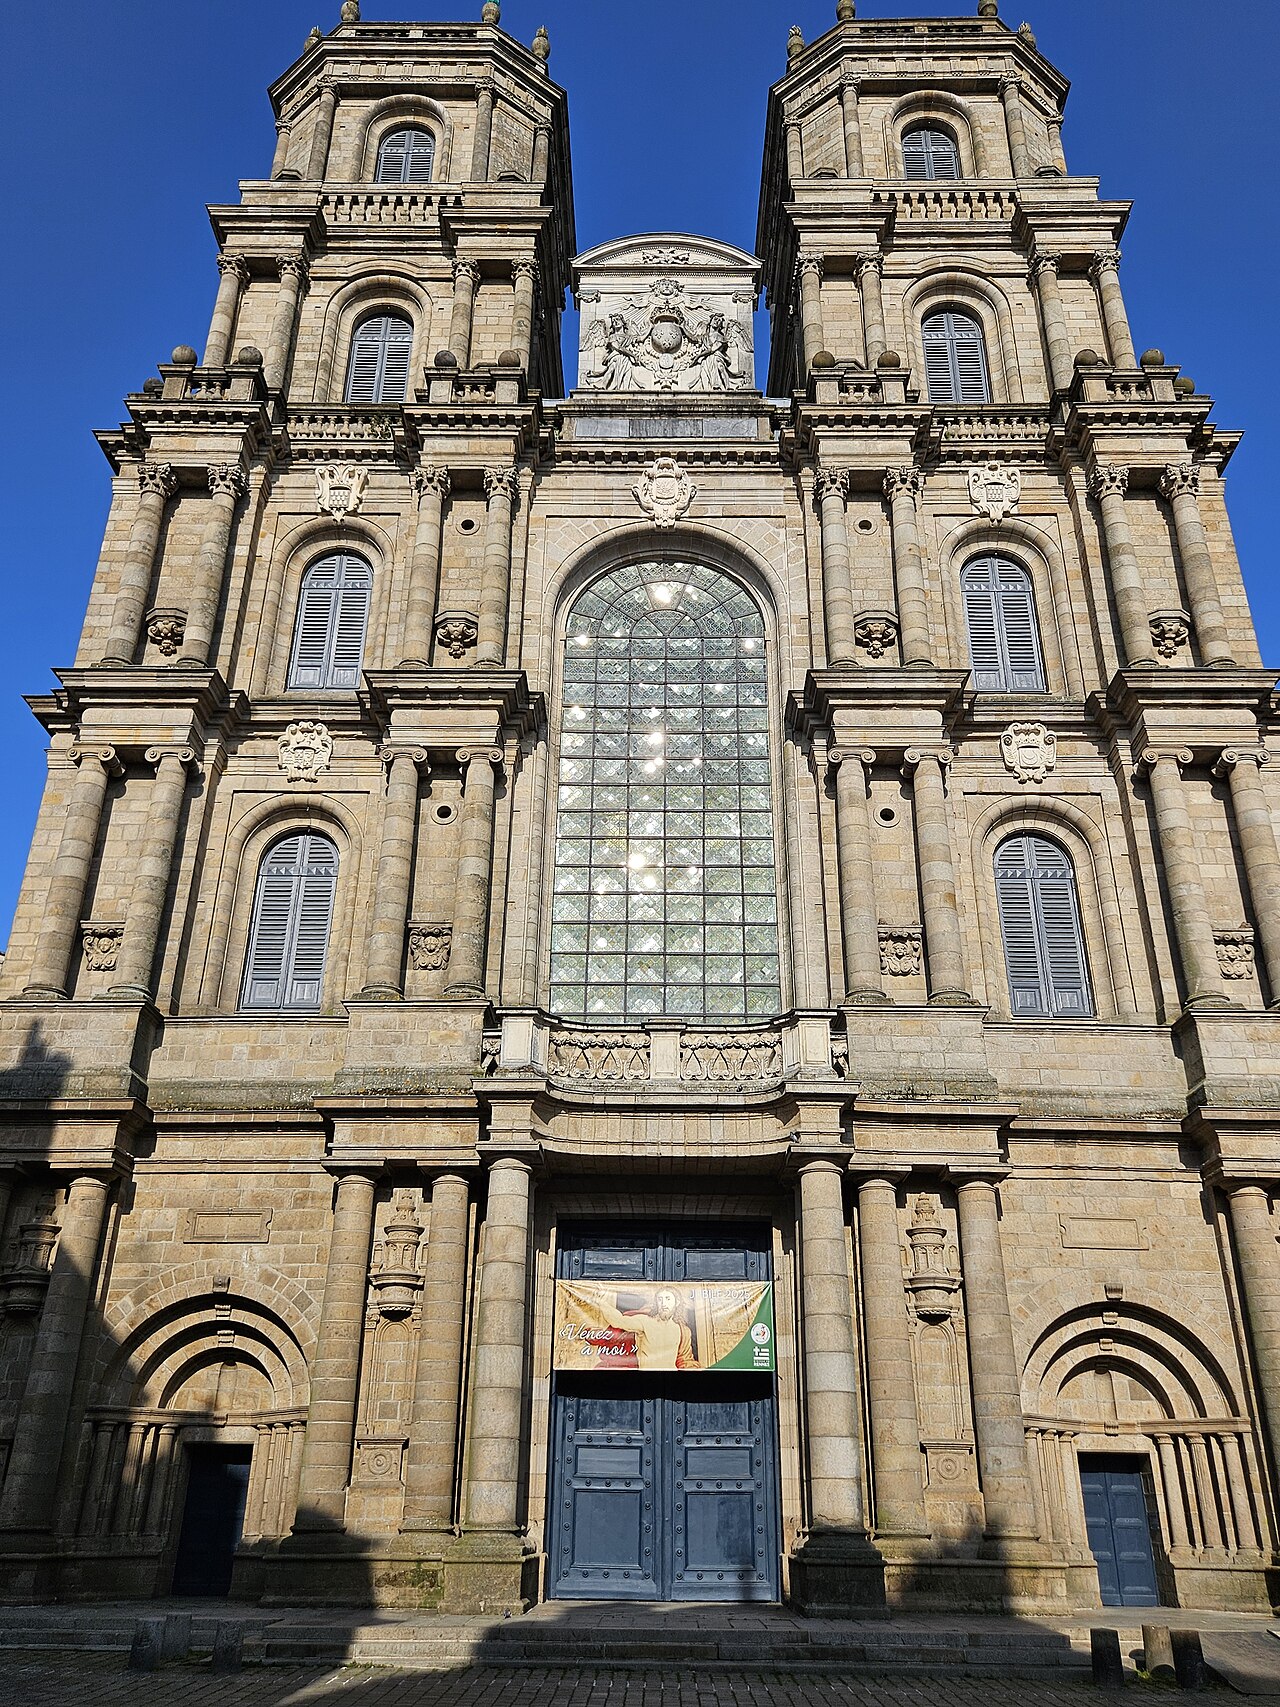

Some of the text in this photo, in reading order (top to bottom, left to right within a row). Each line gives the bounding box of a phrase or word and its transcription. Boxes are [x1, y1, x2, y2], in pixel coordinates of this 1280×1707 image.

[726, 1289, 750, 1299] 2025
[559, 1323, 614, 1340] «Venez
[581, 1341, 638, 1356] à moi.»
